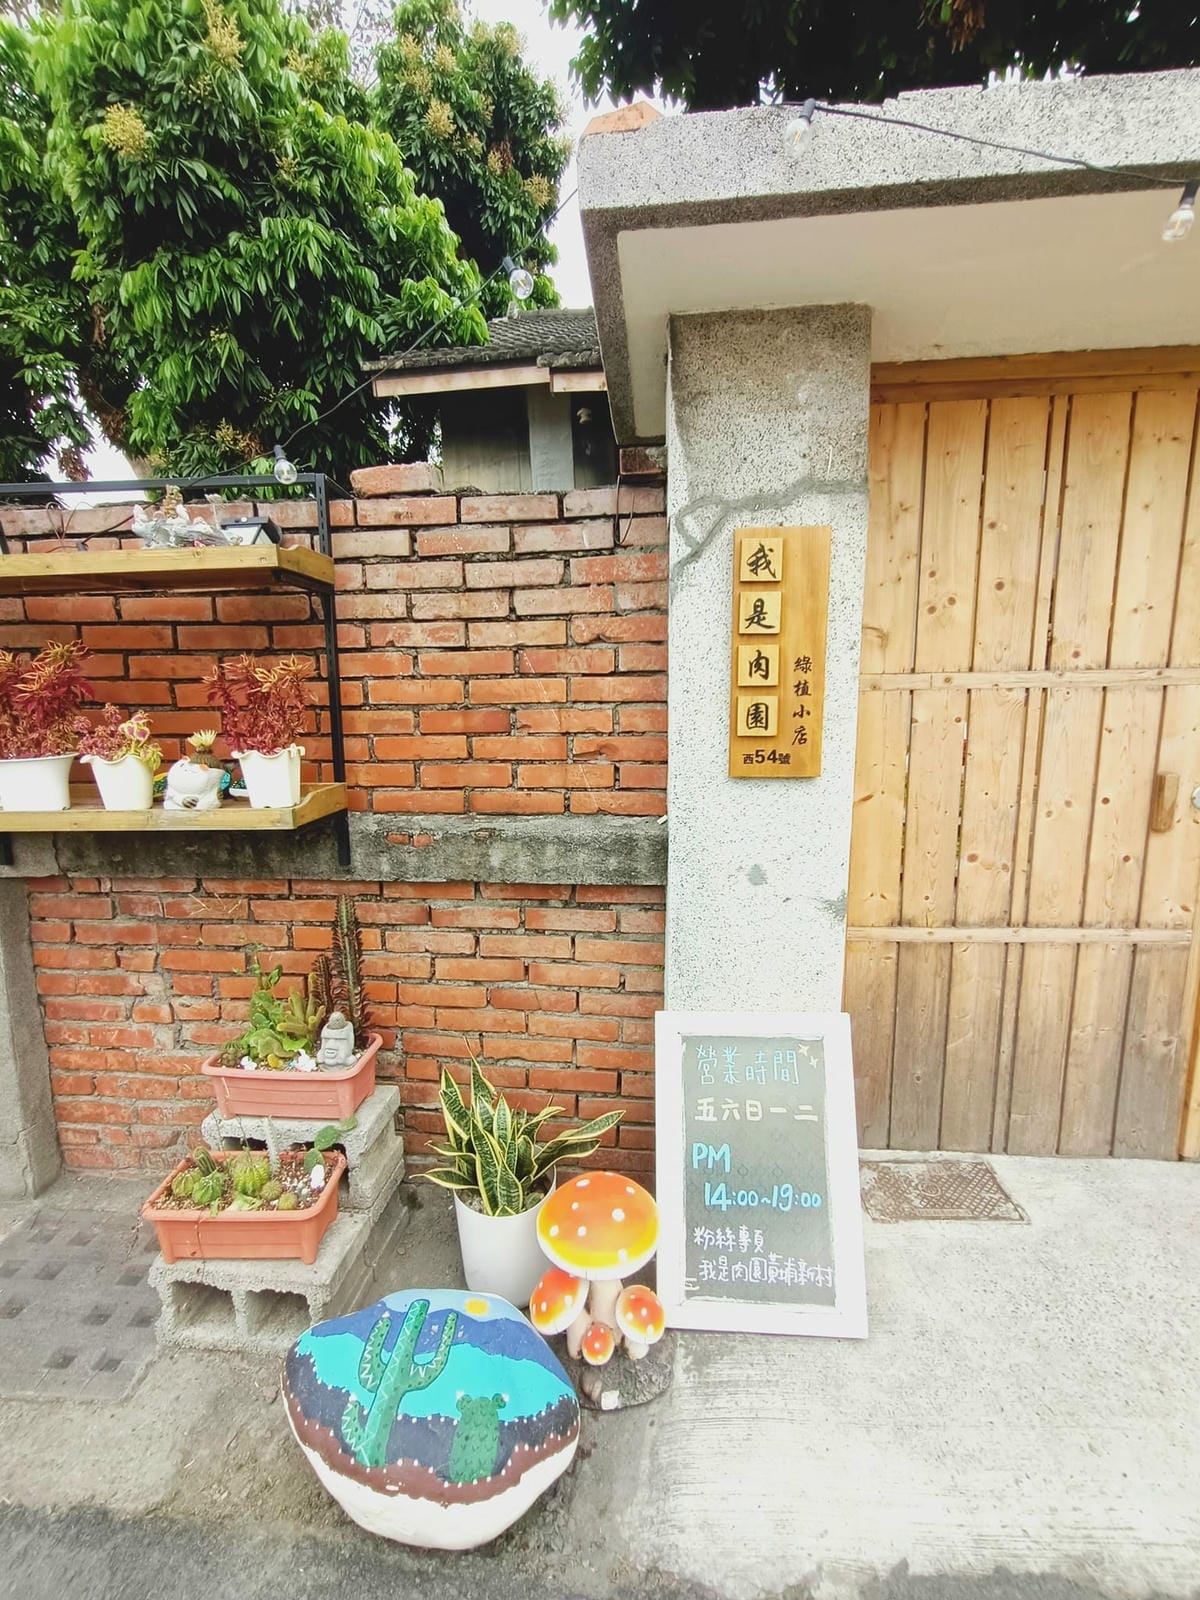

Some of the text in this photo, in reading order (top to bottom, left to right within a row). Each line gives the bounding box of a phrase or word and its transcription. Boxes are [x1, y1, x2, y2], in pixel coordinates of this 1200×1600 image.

[745, 543, 777, 731] 我是肉園
[791, 656, 813, 746] 綠植小店
[695, 1044, 799, 1085] 營業時間
[692, 1142, 731, 1173] PM
[693, 1224, 765, 1253] 粉絲專頁
